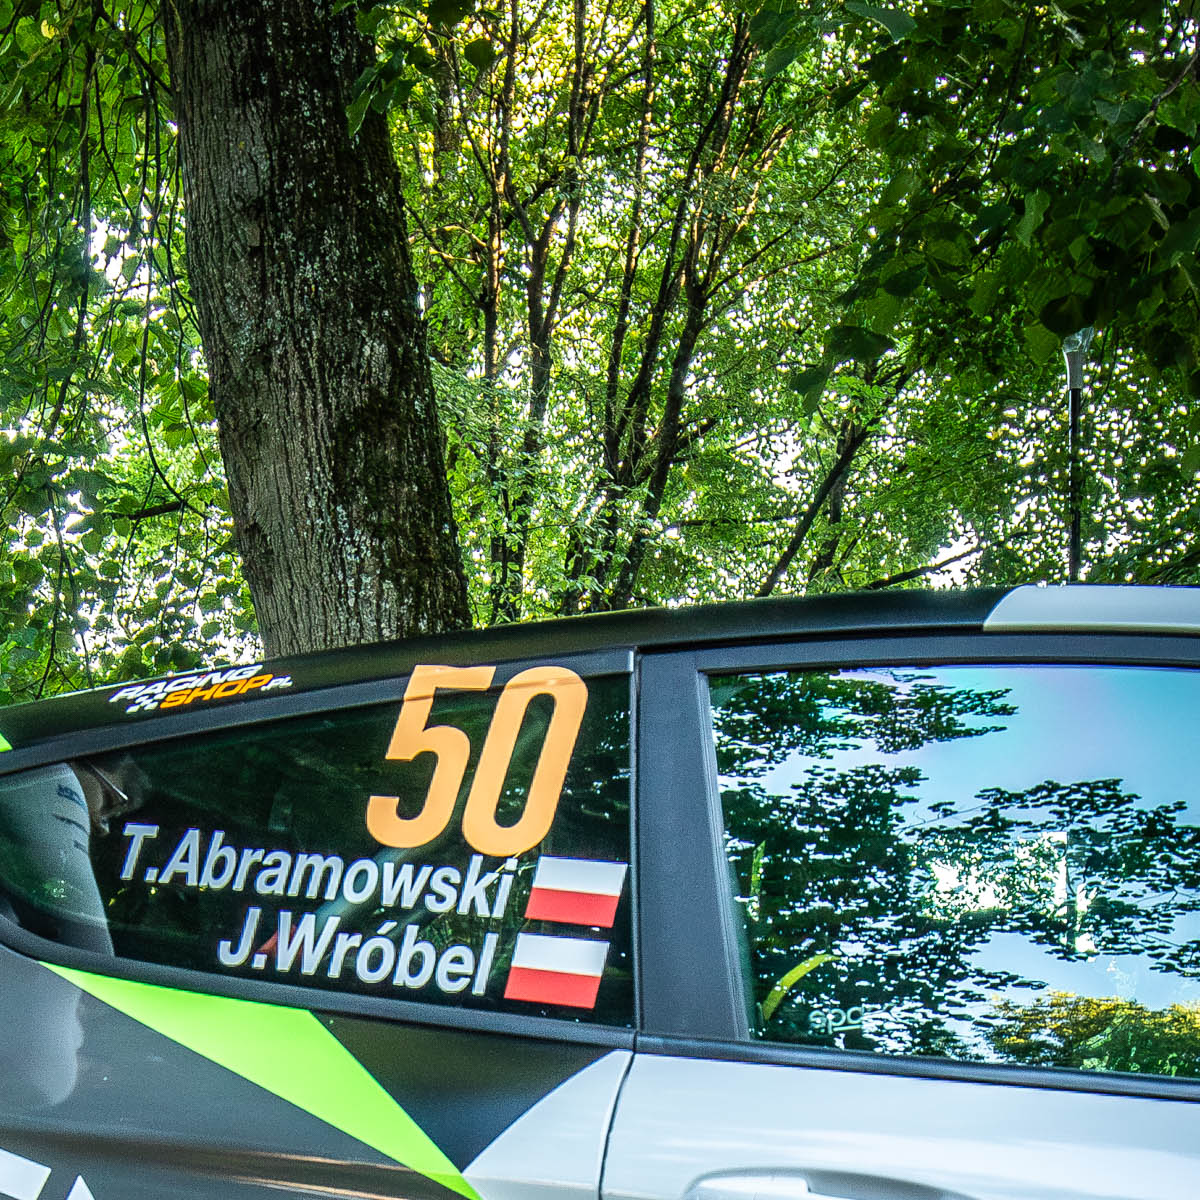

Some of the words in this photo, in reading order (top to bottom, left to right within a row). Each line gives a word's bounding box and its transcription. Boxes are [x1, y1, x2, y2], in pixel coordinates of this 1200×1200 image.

[109, 665, 263, 702] RACING
[366, 665, 589, 857] 50
[120, 823, 518, 919] T.Abramowski
[218, 907, 499, 997] J.Wróbel
